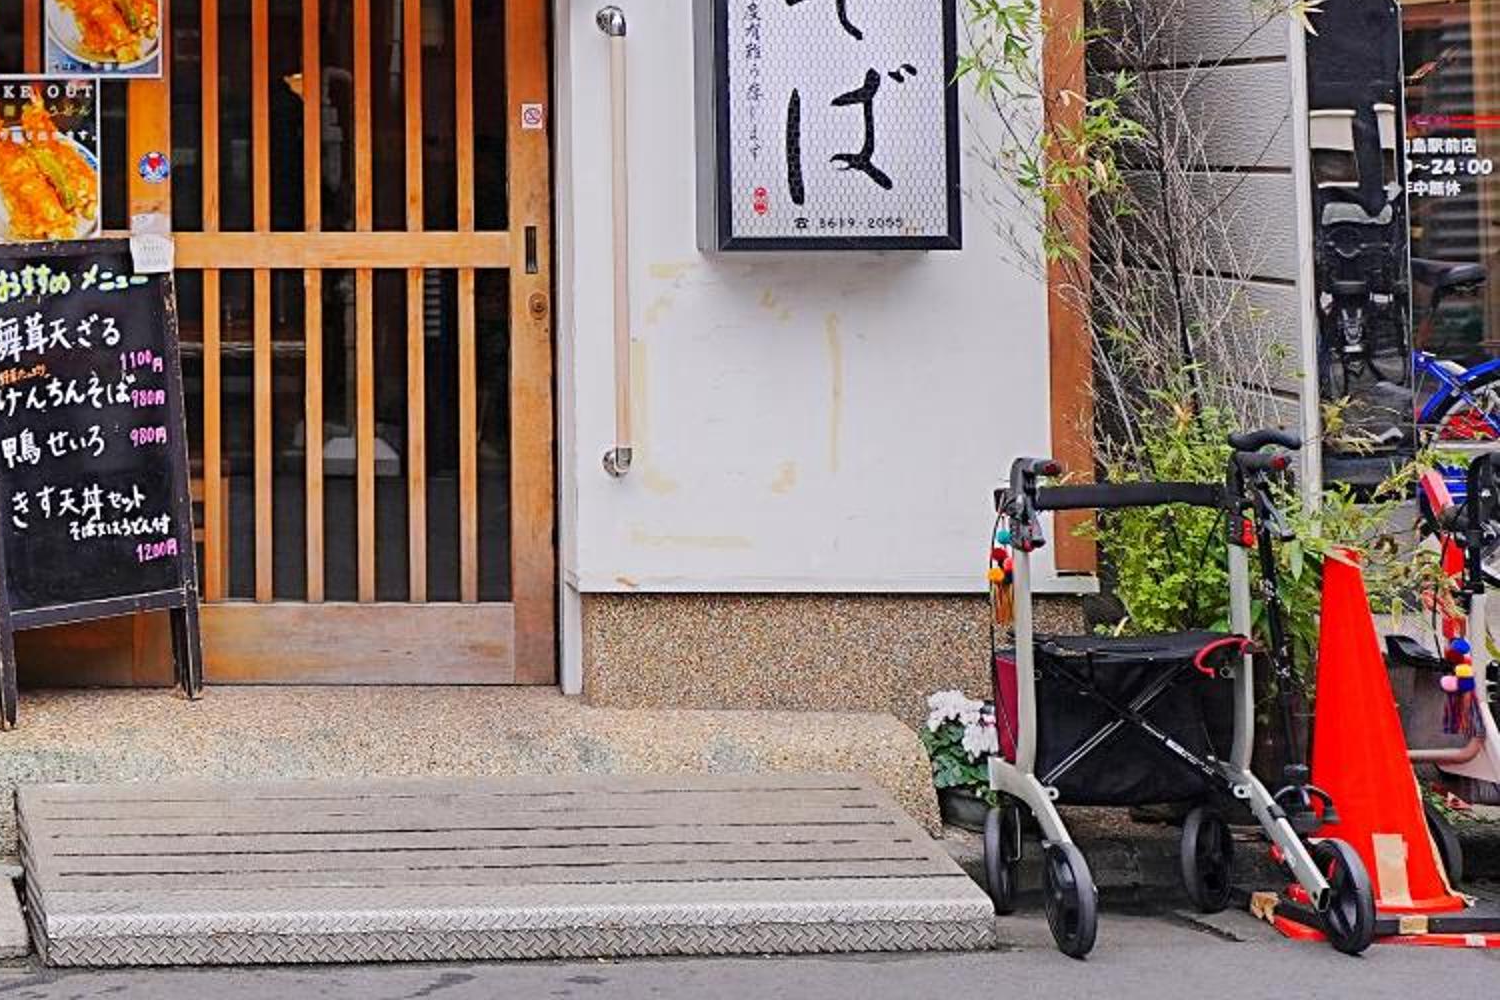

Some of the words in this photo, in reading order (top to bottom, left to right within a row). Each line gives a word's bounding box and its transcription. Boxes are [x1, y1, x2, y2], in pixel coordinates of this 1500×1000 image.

[47, 84, 93, 99] OUT
[81, 263, 149, 291] メニュー
[119, 350, 164, 372] 1100円
[131, 389, 166, 408] 980円
[1, 425, 105, 468] 鴨せいろ
[129, 427, 168, 447] 980円
[11, 483, 146, 529] きす天丼セット
[136, 538, 180, 563] 1200円
